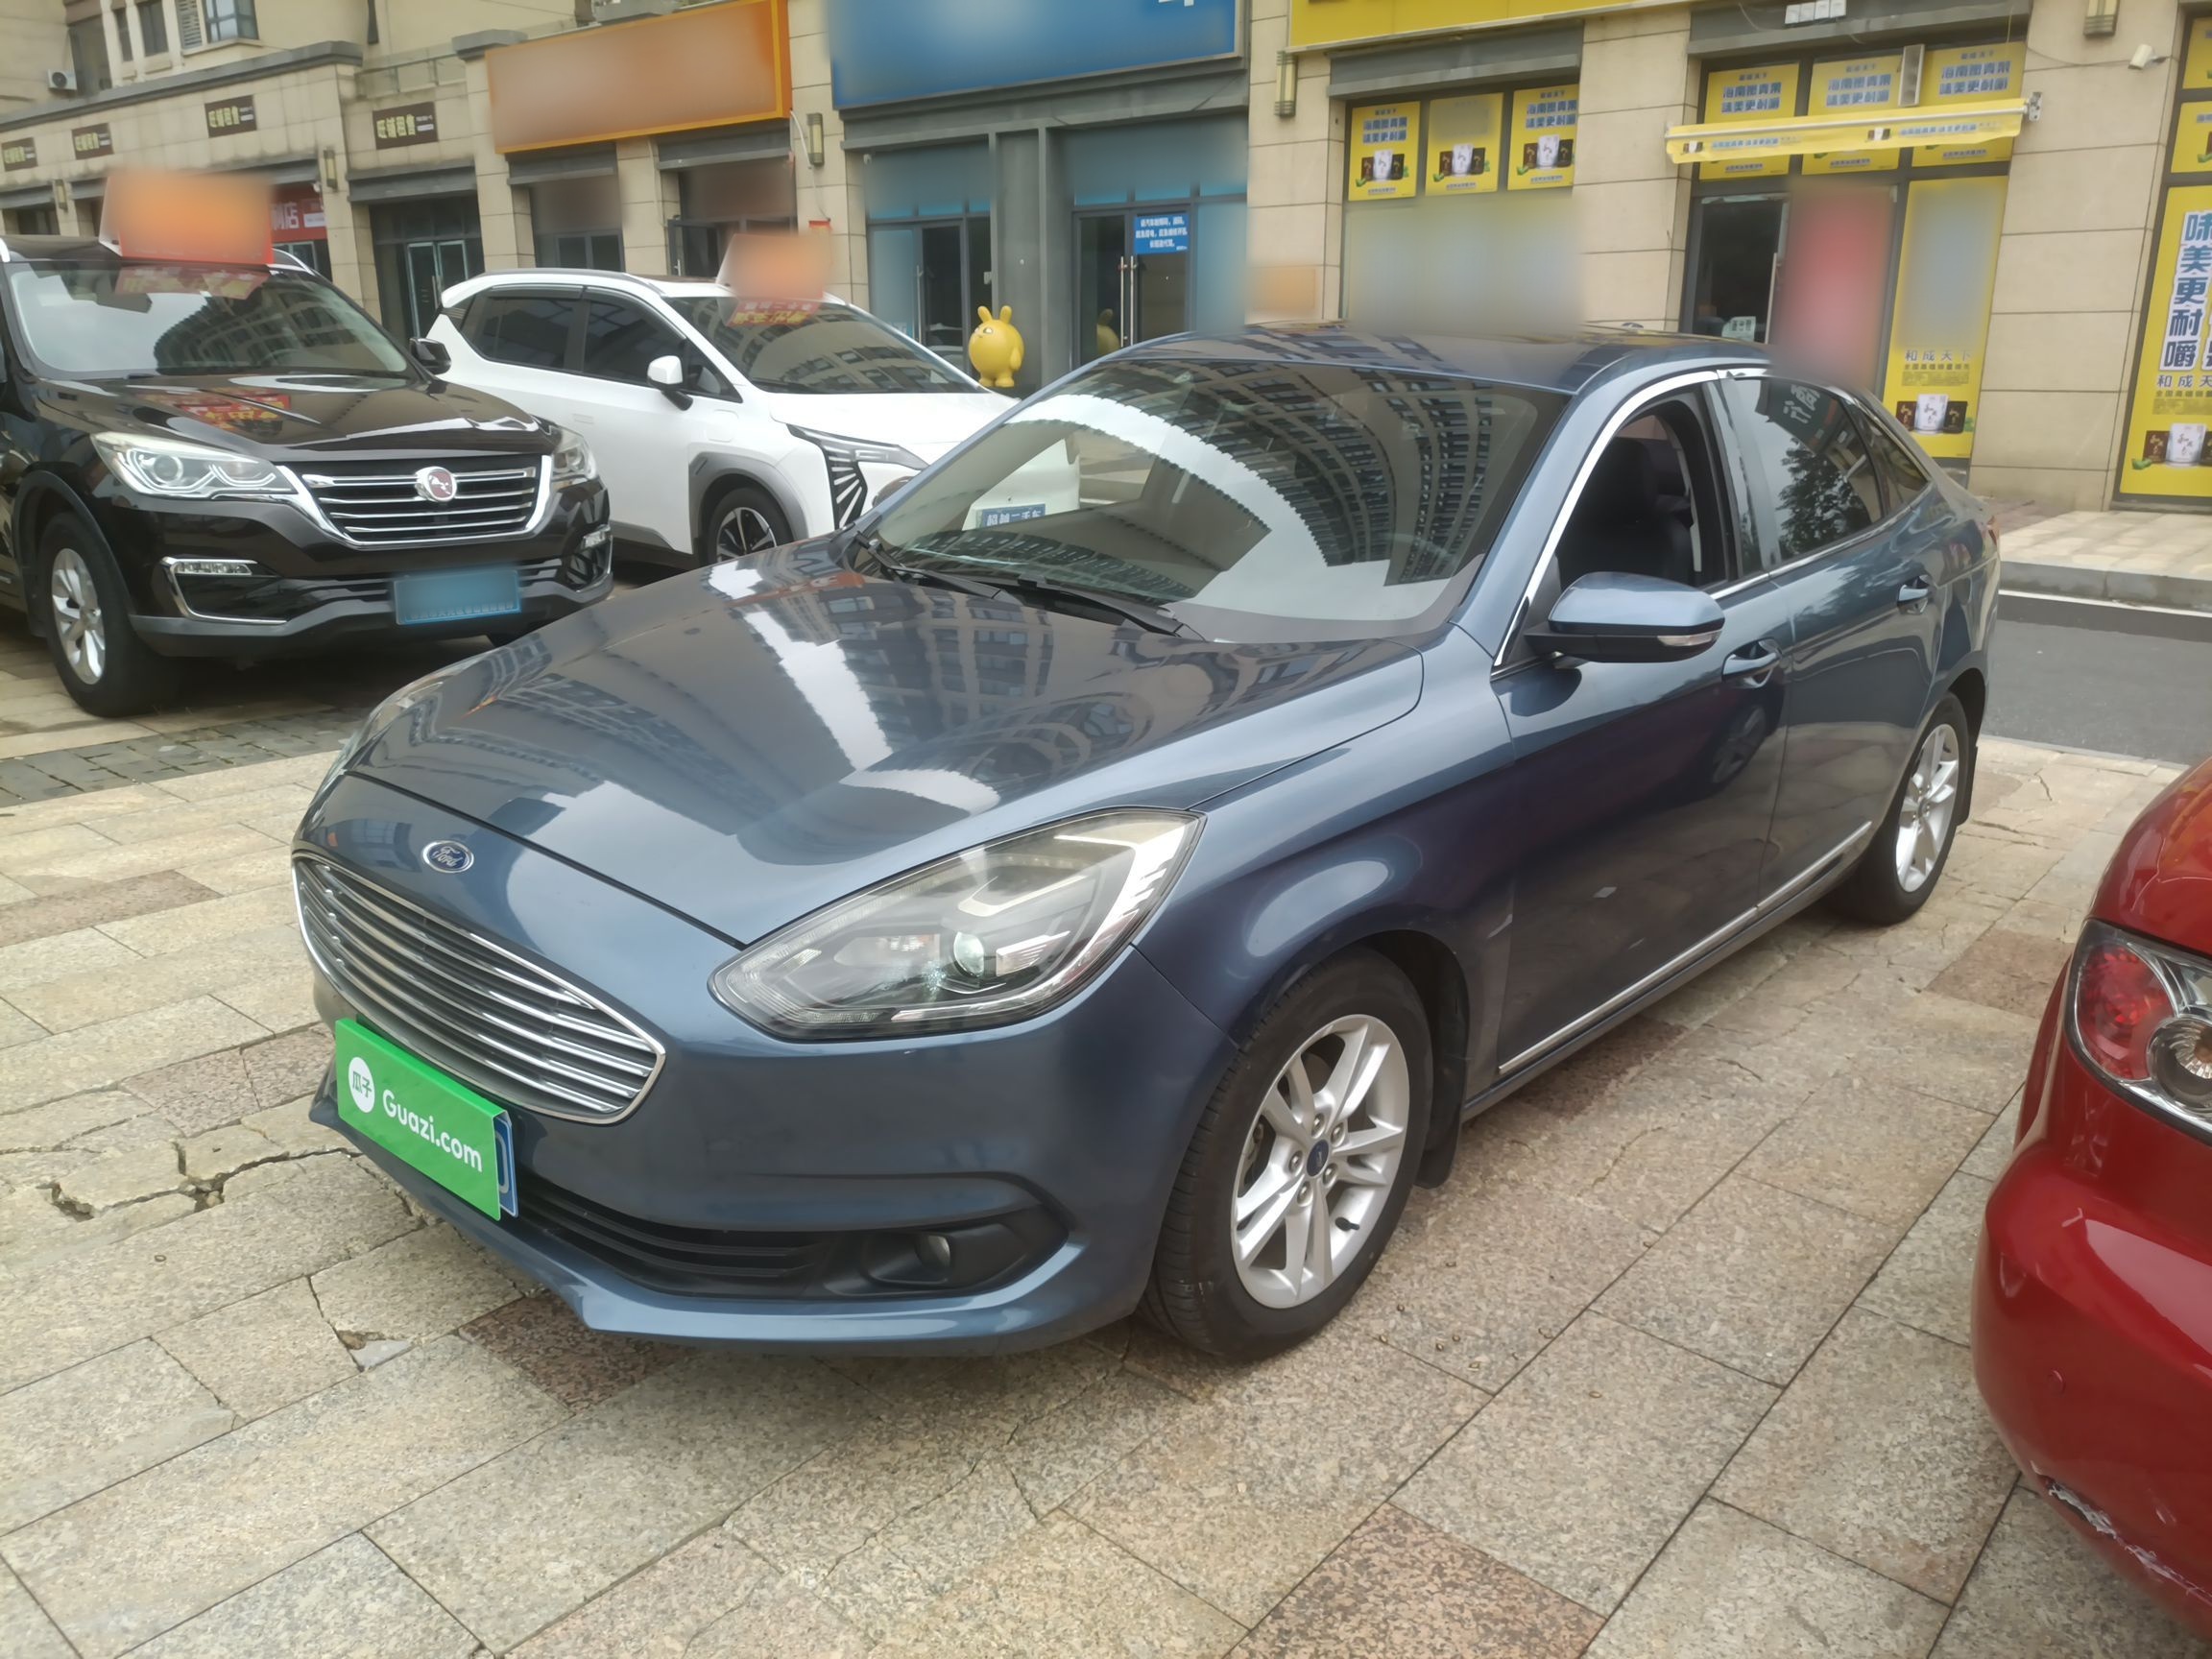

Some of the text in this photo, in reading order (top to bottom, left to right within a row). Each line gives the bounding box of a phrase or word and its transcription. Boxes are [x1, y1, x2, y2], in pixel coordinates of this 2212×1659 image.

[2163, 212, 2212, 368] 味美更耐嚼
[433, 846, 464, 867] Ford
[351, 1070, 373, 1098] 瓜子
[382, 1089, 483, 1172] Guazi.com
